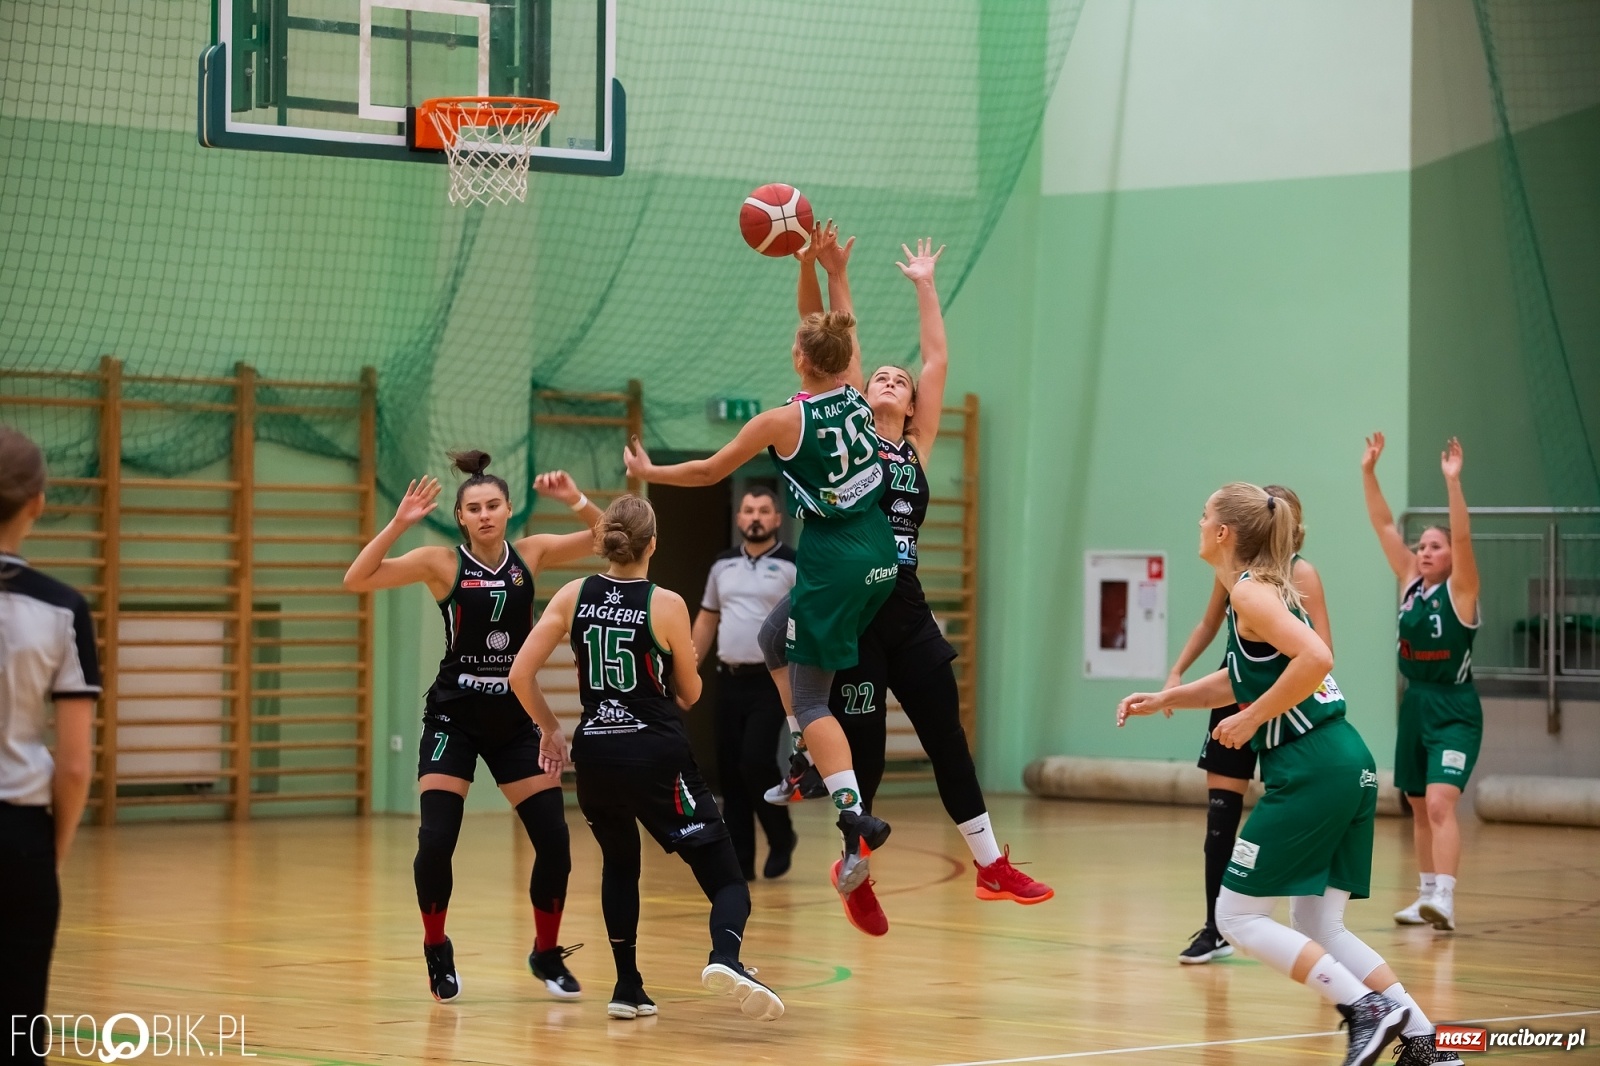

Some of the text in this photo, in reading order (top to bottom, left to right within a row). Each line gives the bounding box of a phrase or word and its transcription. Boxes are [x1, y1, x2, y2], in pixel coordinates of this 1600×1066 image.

[817, 407, 874, 483] 35
[889, 462, 919, 493] 22
[490, 590, 507, 622] 7
[577, 603, 647, 625] ZAGŁĘBIE
[1429, 613, 1442, 638] 3
[460, 655, 479, 663] CTL
[583, 624, 638, 693] 15
[841, 681, 876, 715] 22
[431, 732, 449, 761] 7
